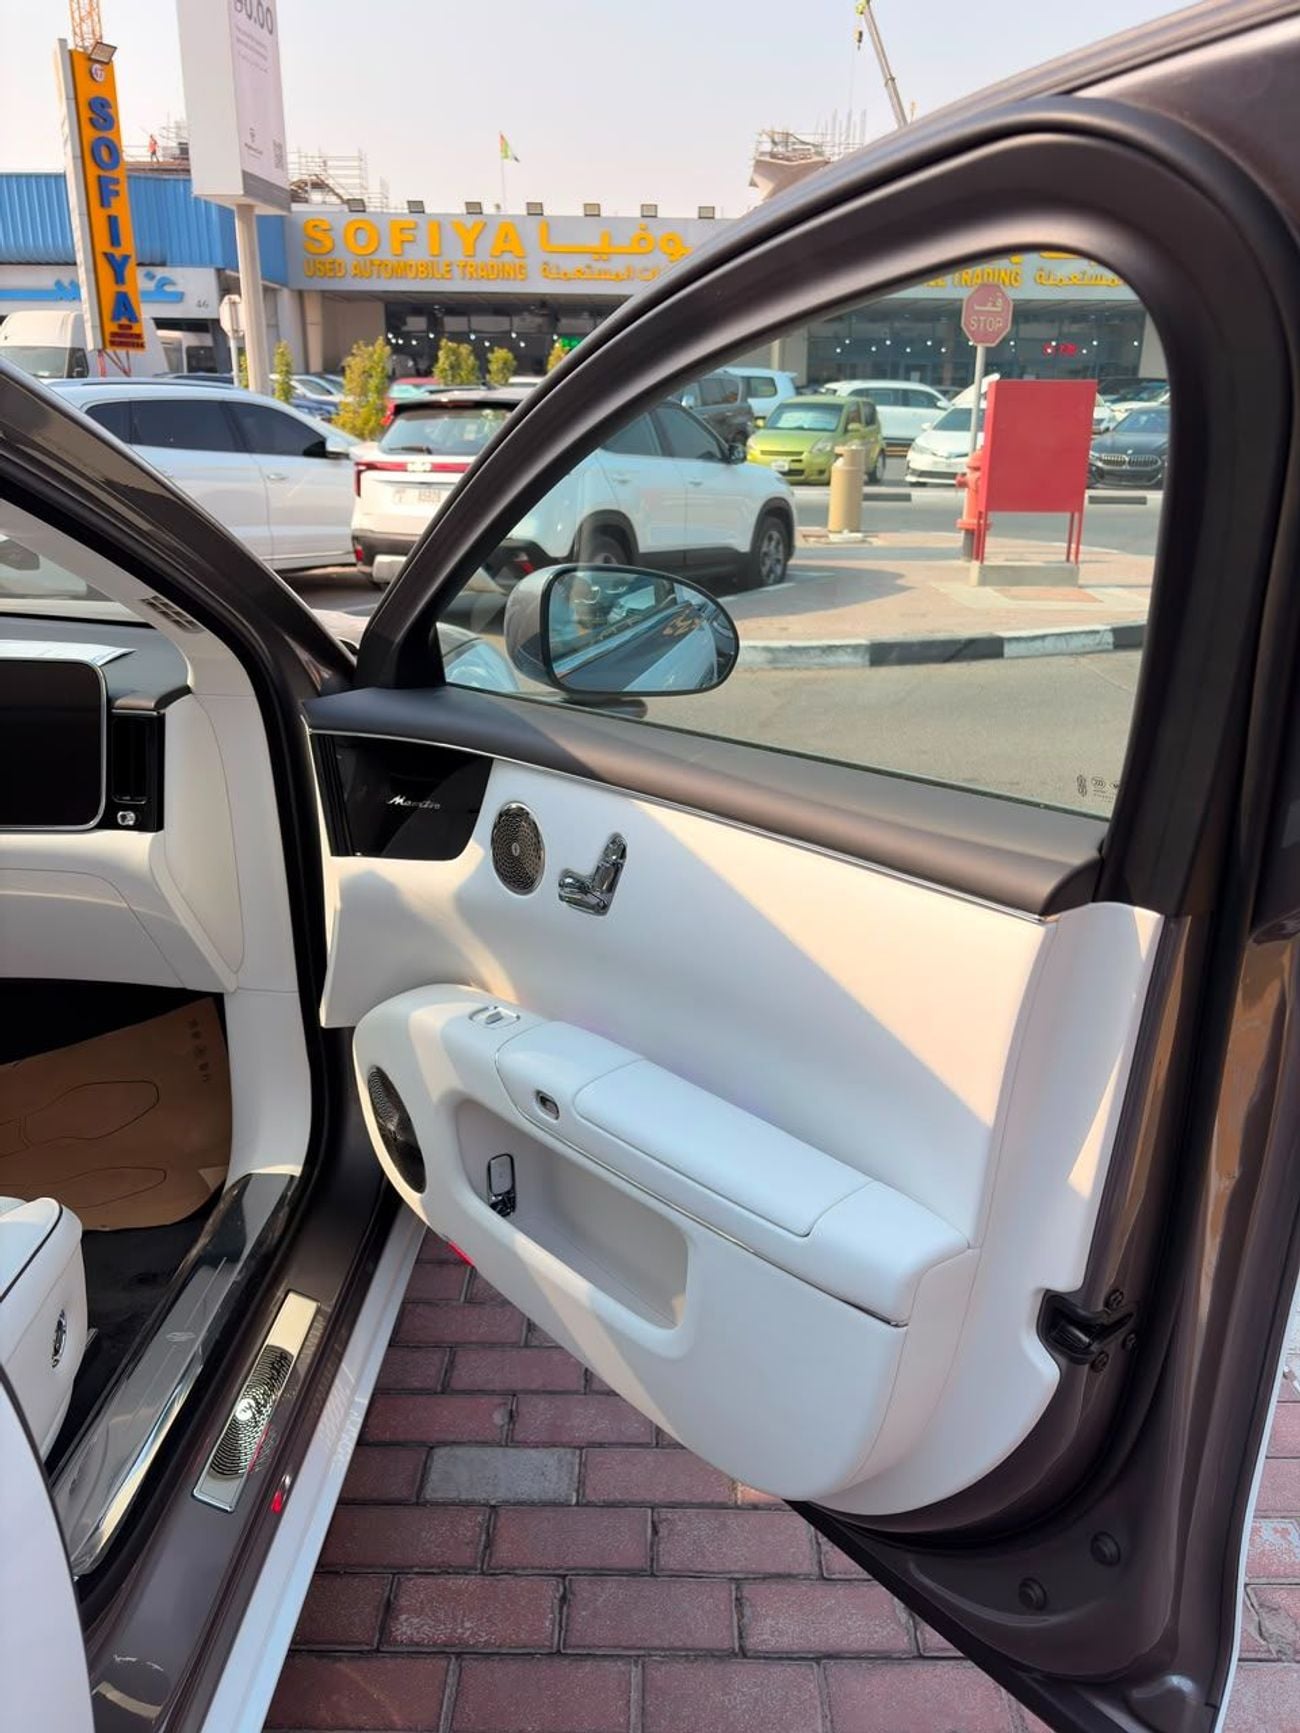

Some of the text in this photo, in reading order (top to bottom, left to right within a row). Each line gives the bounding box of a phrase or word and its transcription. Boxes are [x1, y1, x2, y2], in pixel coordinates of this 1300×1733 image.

[88, 96, 139, 324] SOFIYA
[303, 218, 526, 258] SOFIYA
[538, 218, 693, 263] وفيا
[303, 259, 529, 281] USED AUTOMOBILE TRADING
[973, 292, 1004, 312] قف
[969, 316, 1004, 332] STOP
